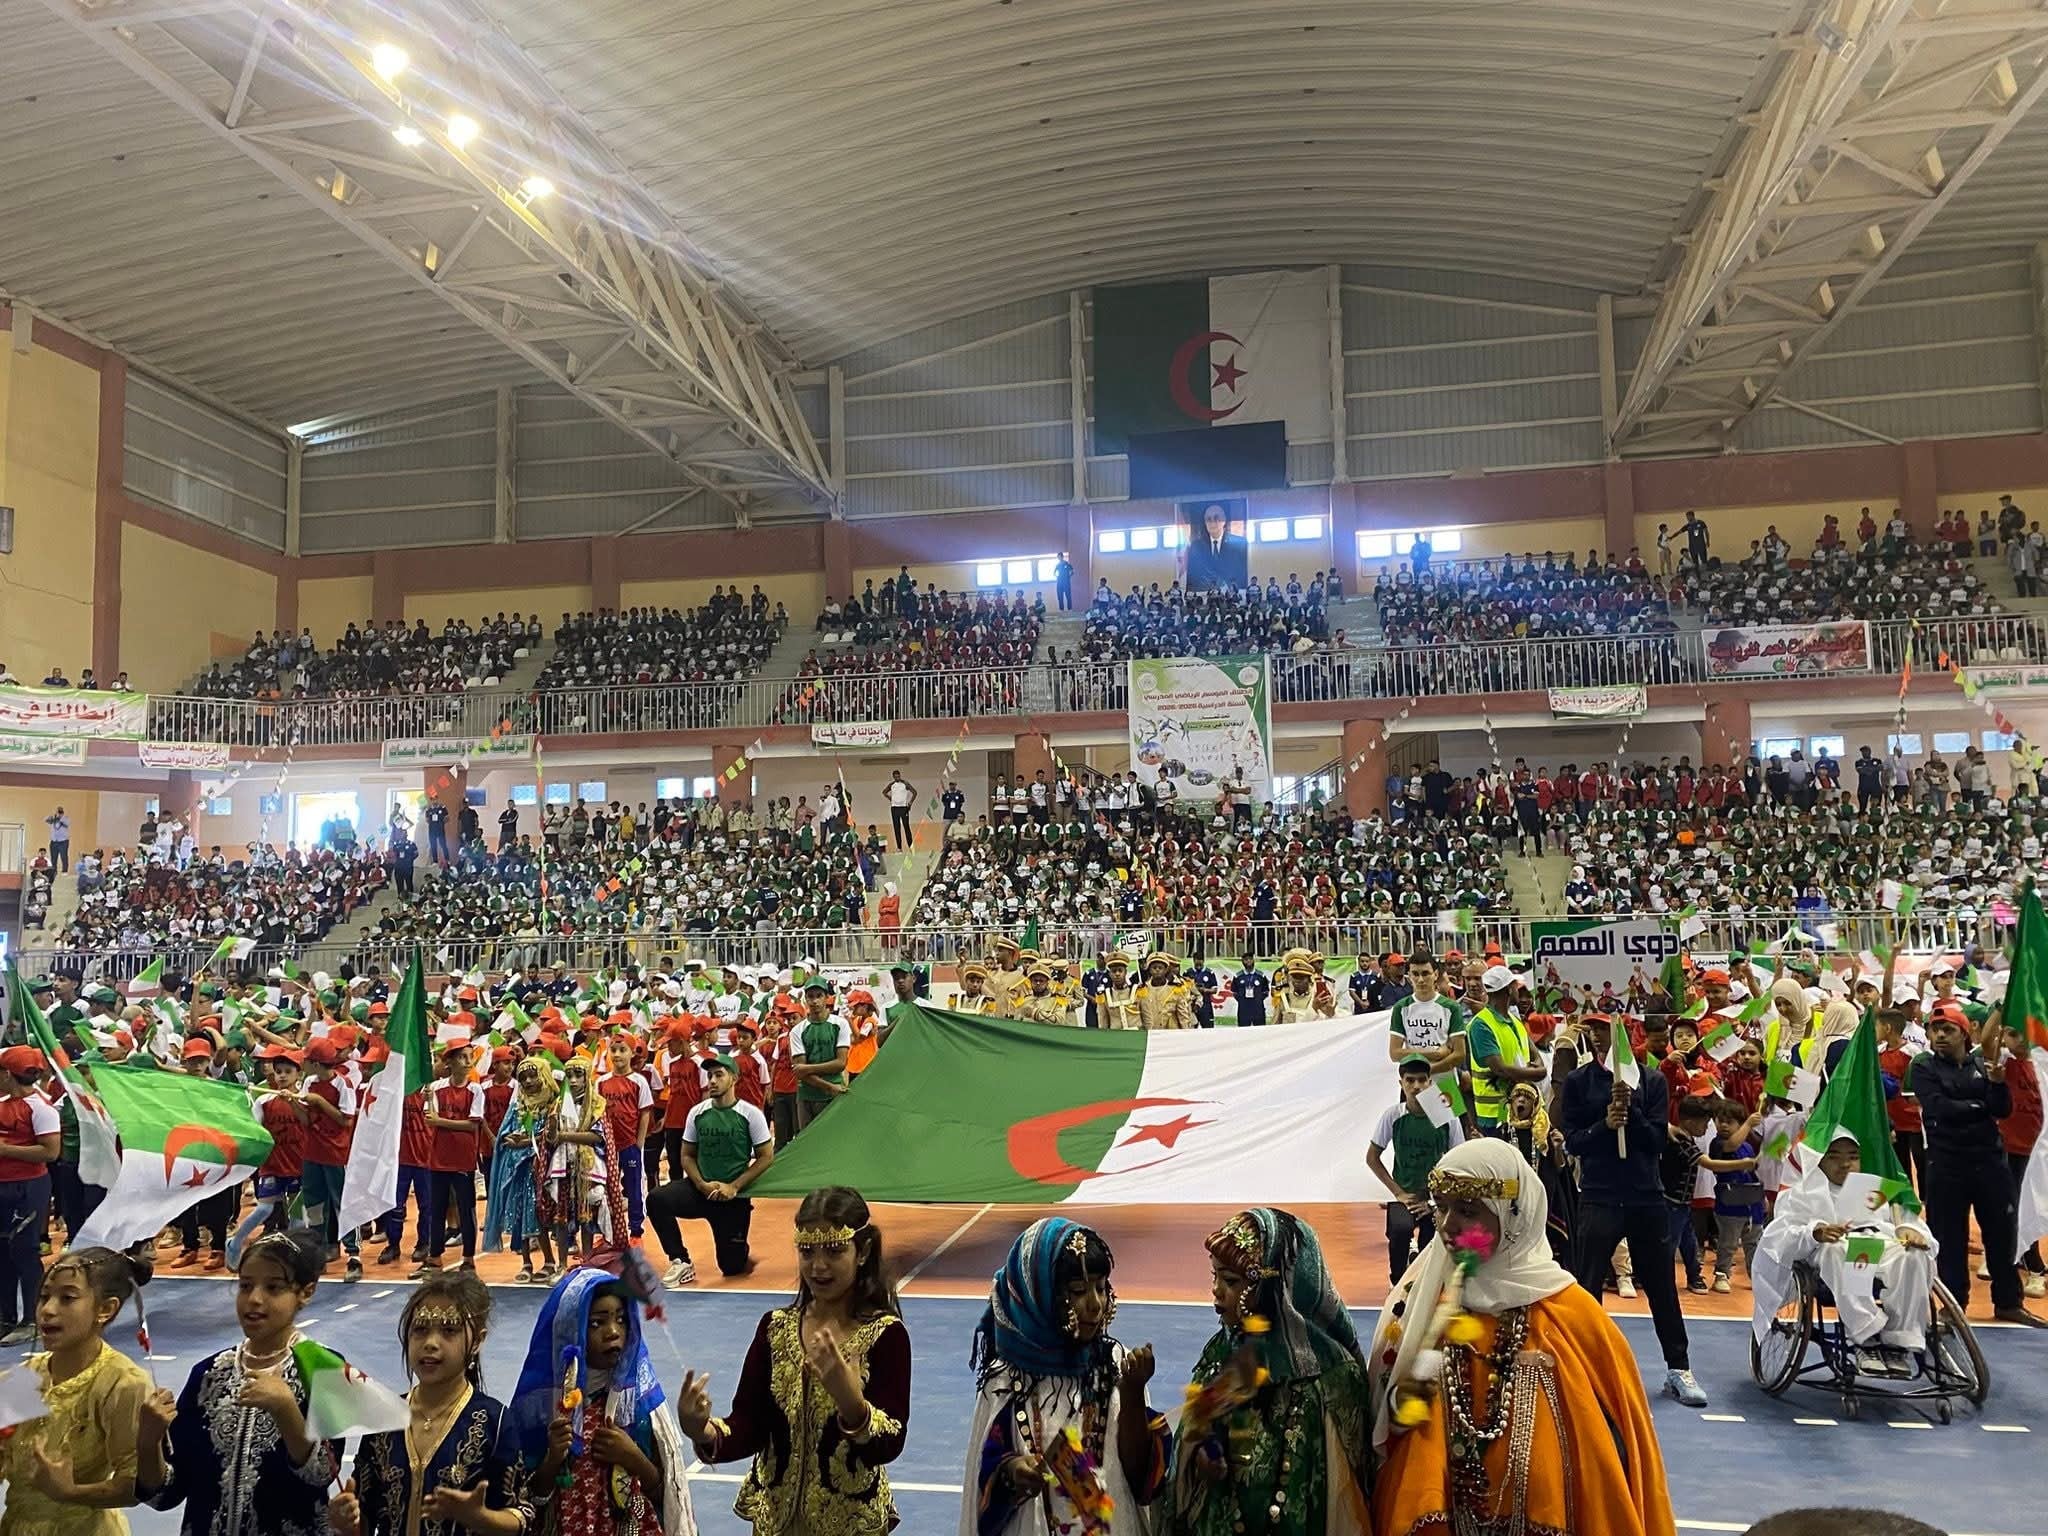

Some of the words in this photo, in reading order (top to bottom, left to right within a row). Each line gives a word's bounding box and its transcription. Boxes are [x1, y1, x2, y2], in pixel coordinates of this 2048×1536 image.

[1120, 931, 1152, 950] الحكام
[1536, 929, 1615, 965] الهمم
[1622, 926, 1680, 963] ذوي
[1415, 1028, 1431, 1039] في
